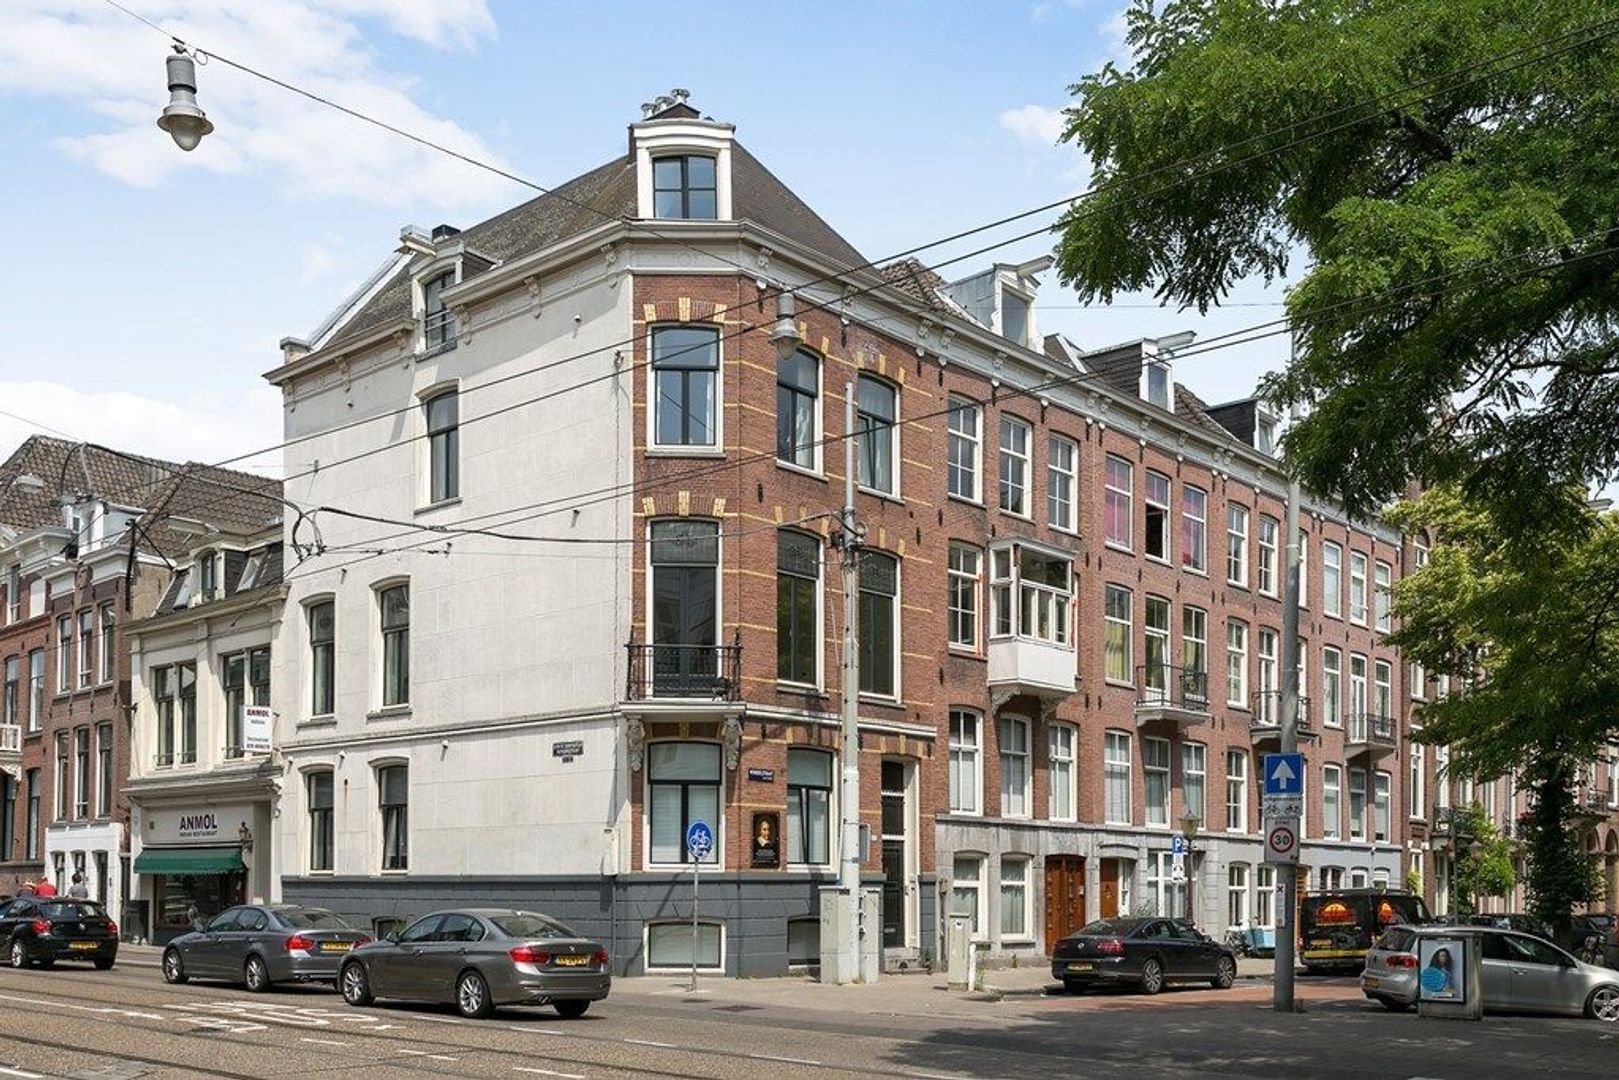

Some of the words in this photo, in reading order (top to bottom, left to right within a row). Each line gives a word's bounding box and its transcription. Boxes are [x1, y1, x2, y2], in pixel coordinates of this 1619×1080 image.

[246, 708, 269, 717] ANMOL
[180, 814, 218, 830] ANMOL
[1175, 837, 1183, 851] P
[1274, 834, 1291, 846] 30
